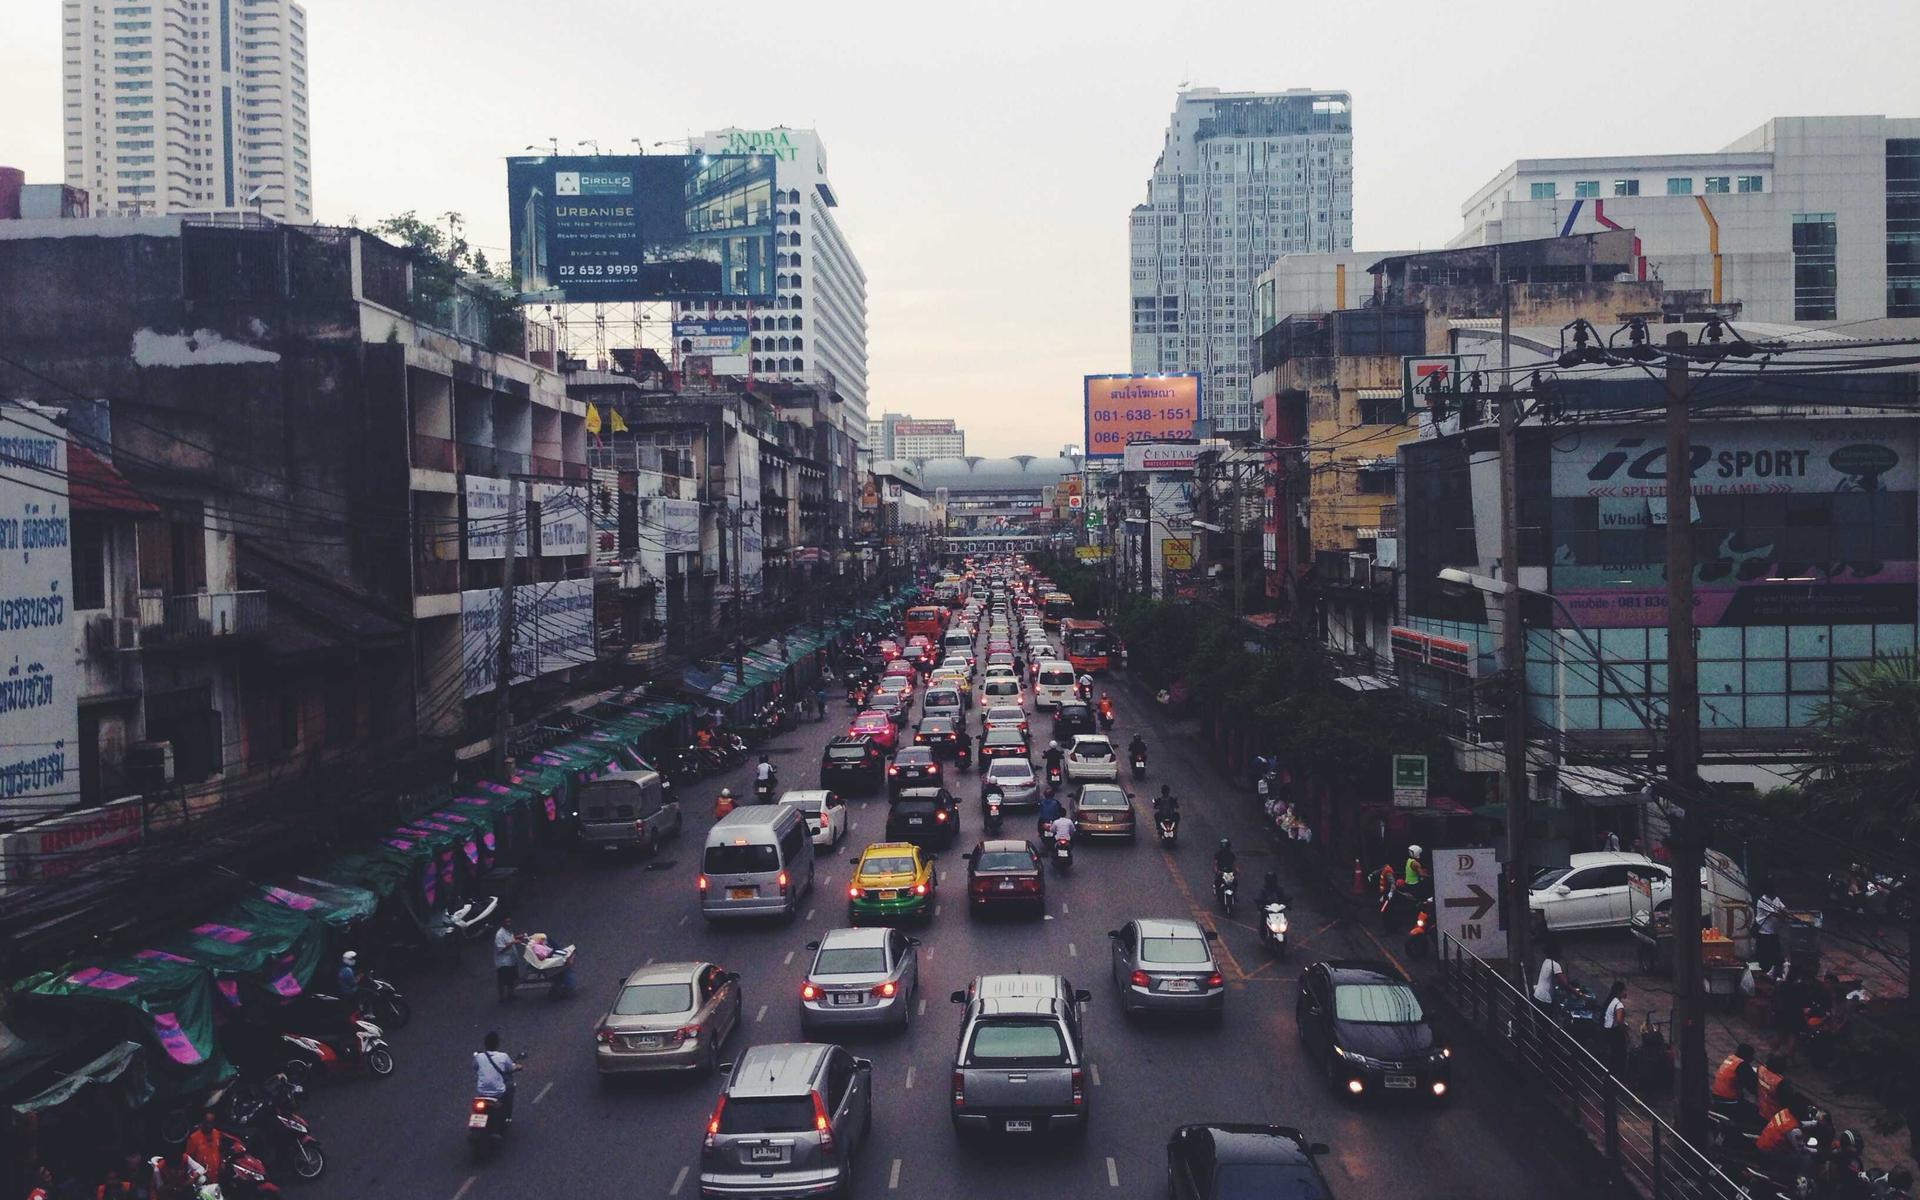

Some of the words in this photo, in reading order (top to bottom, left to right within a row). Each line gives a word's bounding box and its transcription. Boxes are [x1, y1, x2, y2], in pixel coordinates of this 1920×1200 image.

[729, 132, 790, 146] INDRA
[556, 206, 634, 216] URBANISE
[560, 266, 575, 275] 02
[579, 266, 603, 275] 652
[607, 265, 638, 275] 9999
[1094, 408, 1191, 421] 081-638-1551
[1094, 430, 1193, 443] 086-376-1522
[1717, 450, 1810, 478] SPORT
[1460, 924, 1482, 939] IN
